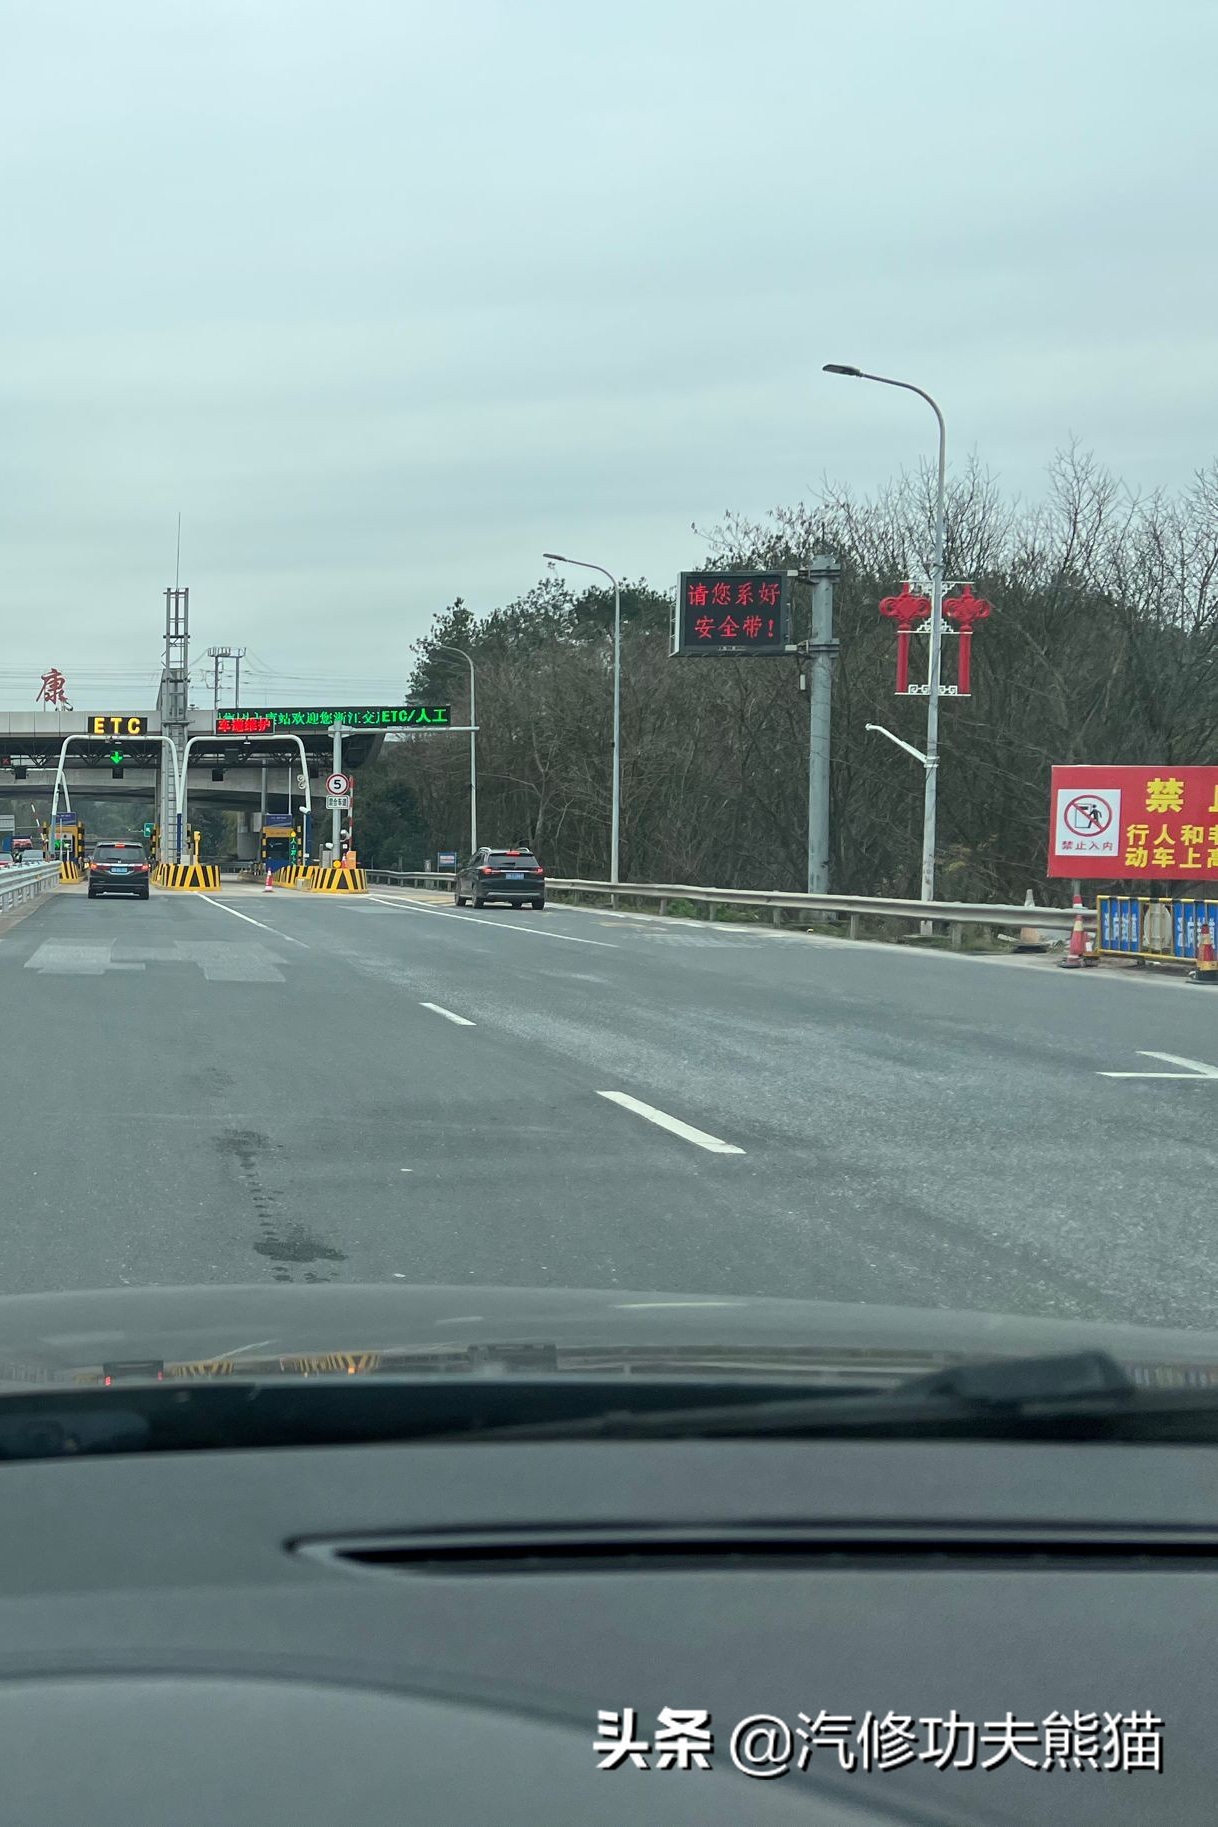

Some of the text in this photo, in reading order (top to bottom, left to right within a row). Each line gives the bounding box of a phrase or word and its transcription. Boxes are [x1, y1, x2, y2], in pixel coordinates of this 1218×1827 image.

[687, 582, 780, 606] 请您系好
[36, 668, 68, 704] 康
[381, 707, 448, 723] ETC/人工
[93, 717, 141, 735] ETC
[333, 779, 342, 790] 5
[1061, 840, 1114, 852] 禁止入内
